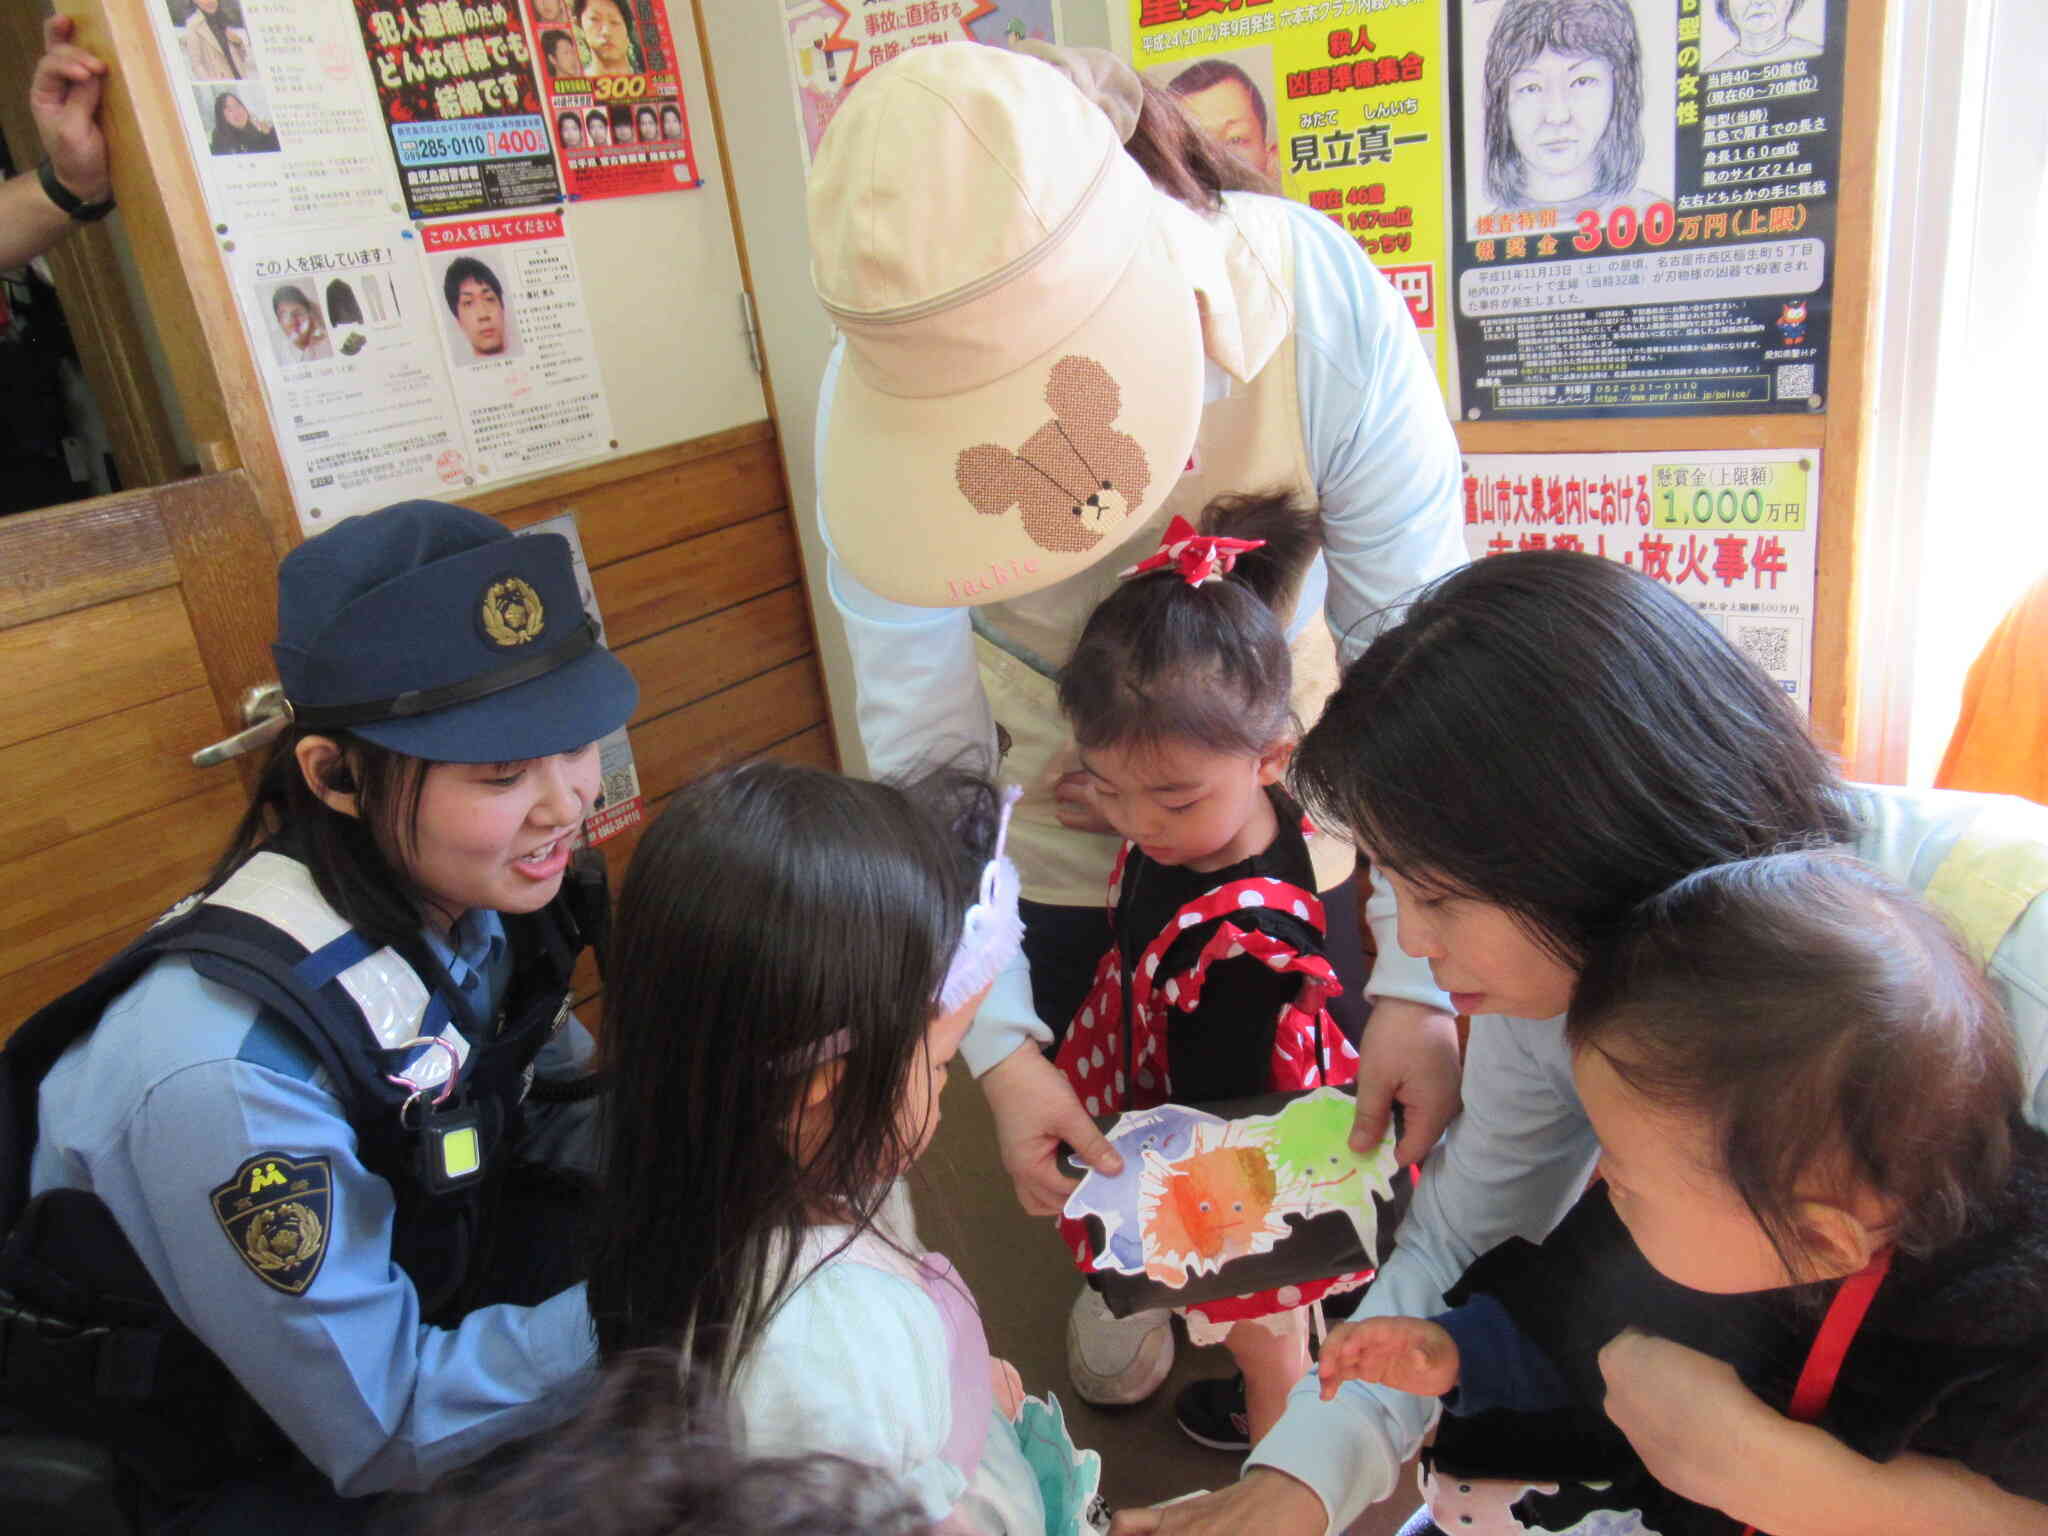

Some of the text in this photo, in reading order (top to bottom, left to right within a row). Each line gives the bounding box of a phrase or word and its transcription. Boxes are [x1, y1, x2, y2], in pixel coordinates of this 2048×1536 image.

[371, 1, 508, 46] 犯人逮捕のため
[863, 1, 962, 37] 事故に直結する
[377, 31, 529, 87] どんな情報でも
[1328, 24, 1376, 59] 殺人
[594, 75, 646, 99] 300
[1286, 52, 1424, 99] 凶器準備集合
[434, 72, 519, 119] 結構です
[1299, 98, 1417, 128] みたて しんいち
[499, 129, 537, 153] 400
[1290, 124, 1428, 175] 見立真一
[429, 218, 557, 245] この人を探してください
[255, 247, 394, 277] この人を探しています！
